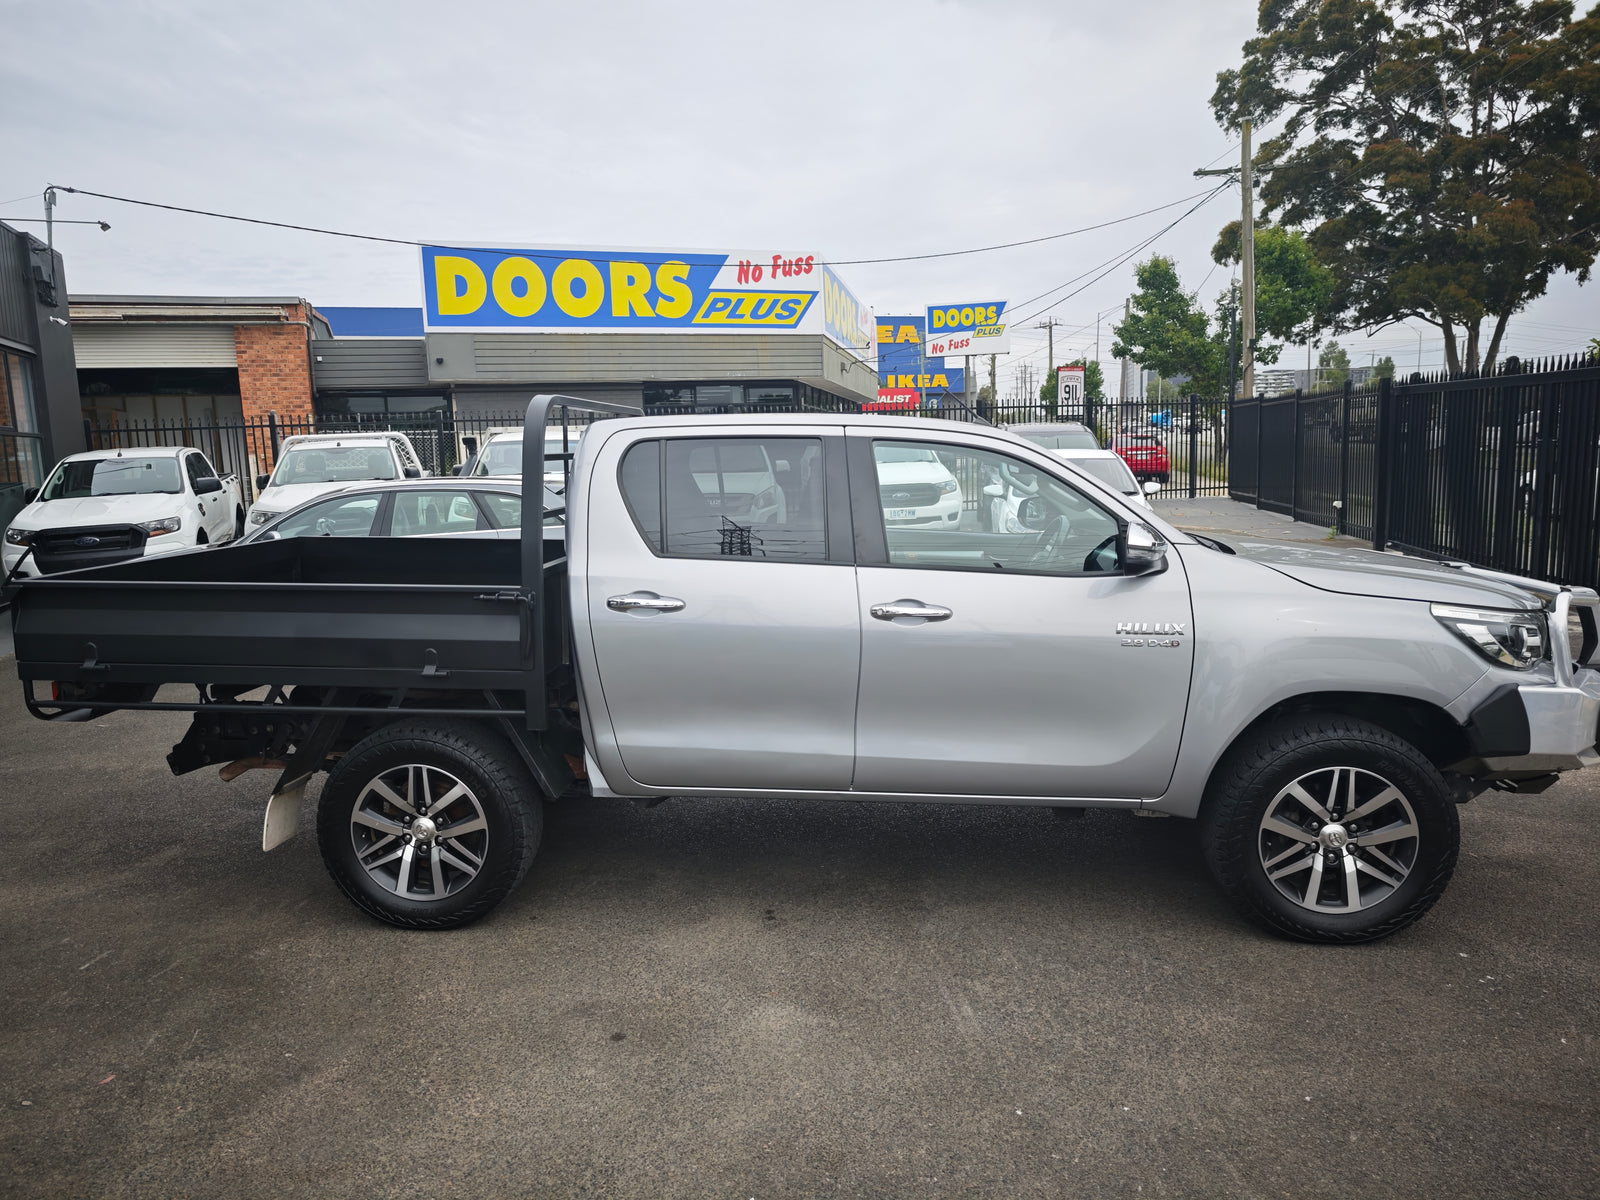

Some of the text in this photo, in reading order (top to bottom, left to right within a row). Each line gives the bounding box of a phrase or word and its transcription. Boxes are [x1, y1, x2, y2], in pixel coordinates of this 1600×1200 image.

[737, 254, 814, 285] No Fuss
[434, 255, 693, 319] DOORS
[701, 297, 802, 321] PLUS
[824, 270, 857, 346] DOORS
[932, 305, 997, 329] DOORS
[976, 326, 1001, 336] PLUS
[931, 338, 970, 355] No Fuss
[887, 374, 949, 388] IKEA
[1063, 384, 1078, 401] 911
[1116, 622, 1186, 635] HILUX
